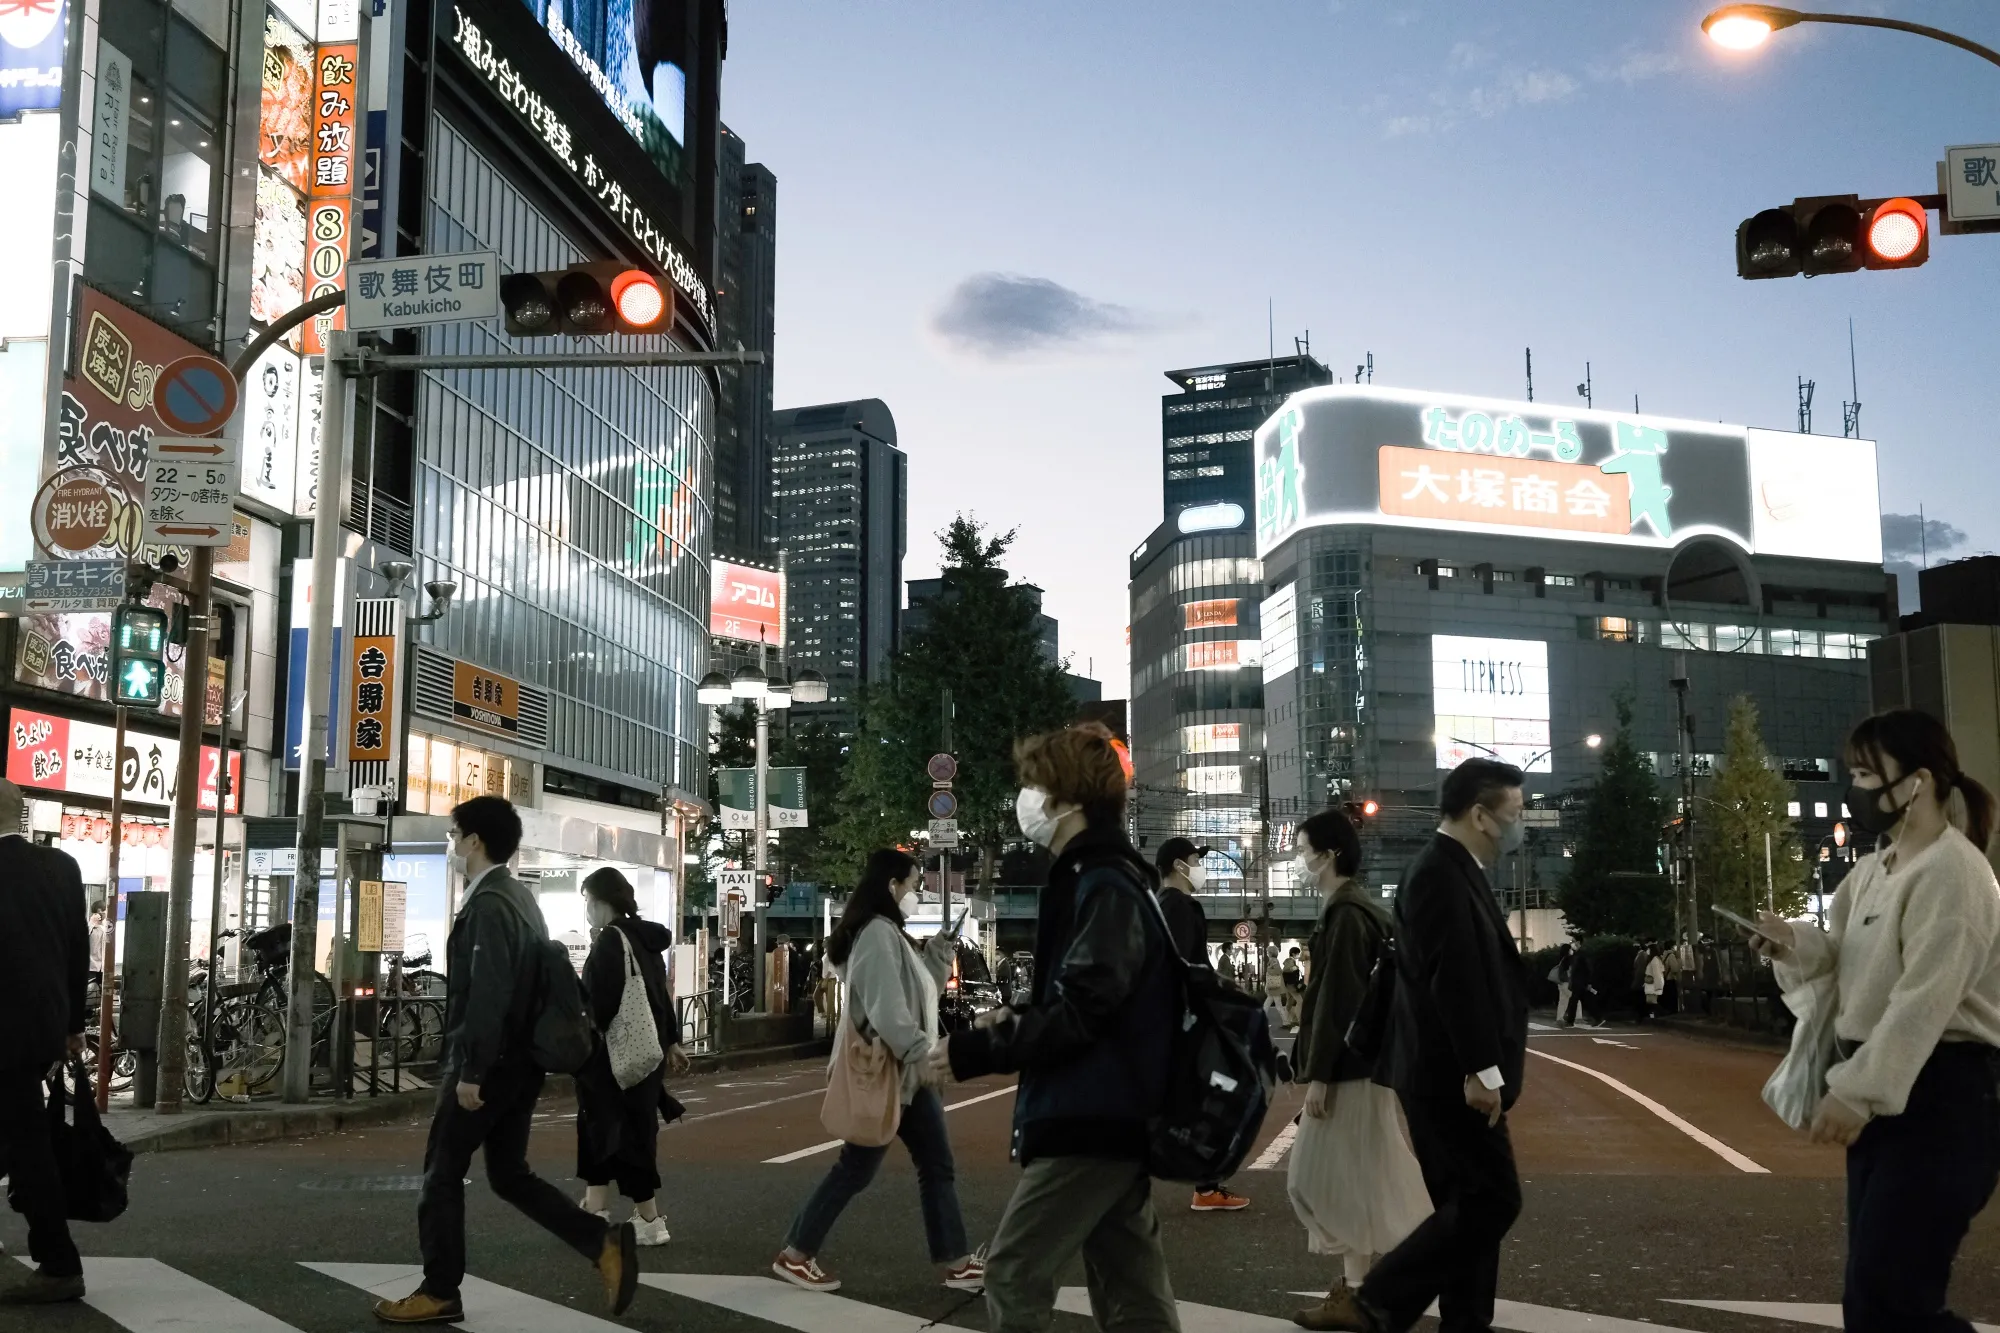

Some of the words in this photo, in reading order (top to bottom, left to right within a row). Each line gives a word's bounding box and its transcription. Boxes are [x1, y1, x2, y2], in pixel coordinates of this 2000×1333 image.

[100, 92, 114, 180] Rydia
[317, 55, 353, 187] 飲み放題
[1963, 156, 1998, 186] 歌
[358, 262, 485, 299] 歌舞伎町
[383, 297, 462, 317] Kabukicho
[94, 326, 123, 369] 炭火
[89, 350, 121, 393] 焼肉
[1426, 407, 1582, 461] たのめーる
[156, 467, 178, 484] 22
[206, 469, 226, 485] 5の
[1400, 464, 1611, 518] 大塚商会
[57, 489, 72, 498] FIRE
[73, 487, 103, 497] HYDRANT
[150, 487, 229, 505] タクシーの客待ち
[51, 500, 109, 530] 消火栓
[149, 505, 185, 521] を除く
[51, 562, 124, 587] セキネ
[42, 587, 114, 598] 03-3352-7325
[50, 599, 94, 610] アルタ裏
[96, 598, 119, 609] 買取
[731, 581, 776, 609] アコム
[725, 619, 741, 634] 2F
[472, 674, 503, 707] 吉野家
[1462, 658, 1524, 696] TIPNESS
[208, 689, 222, 703] TAX
[355, 645, 388, 751] 吉野家
[470, 707, 502, 727] YOSHINOYA
[15, 719, 52, 750] ちょい
[33, 749, 62, 781] 飲み
[466, 762, 480, 787] 2F
[487, 767, 506, 793] 客席
[287, 853, 297, 861] FR
[720, 873, 751, 884] TAXI
